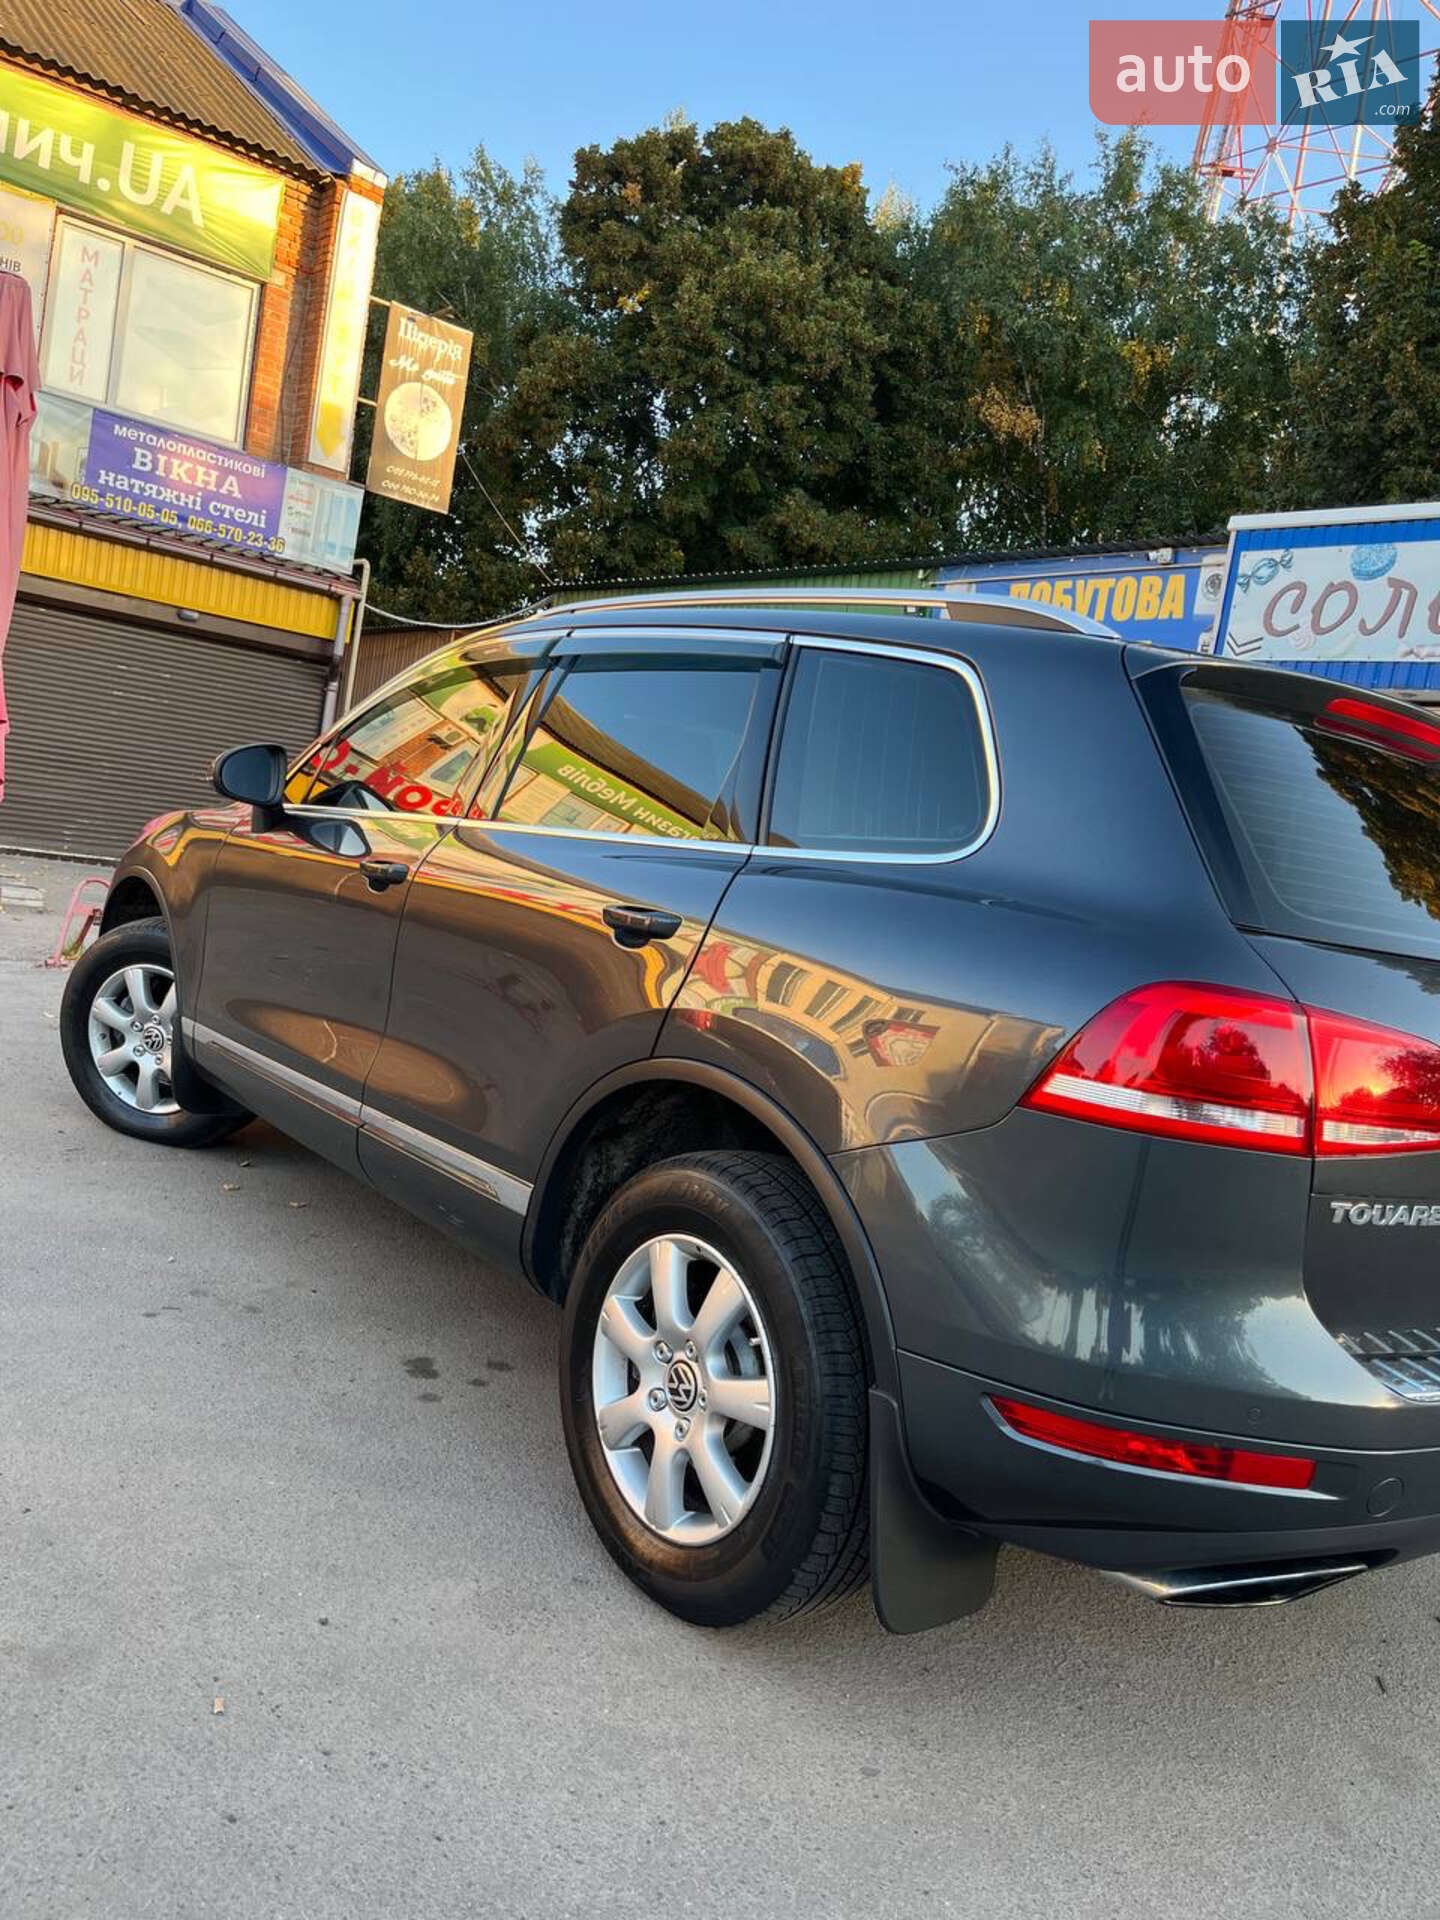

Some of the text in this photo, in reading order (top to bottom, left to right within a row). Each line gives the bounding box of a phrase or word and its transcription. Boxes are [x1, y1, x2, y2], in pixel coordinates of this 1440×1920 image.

[0, 110, 205, 229] ич.UA
[113, 423, 266, 479] металопластикові
[132, 446, 242, 499] ВІКНА
[98, 469, 202, 511] натяжні
[208, 499, 267, 529] стелі
[1263, 577, 1440, 639] СОЛ
